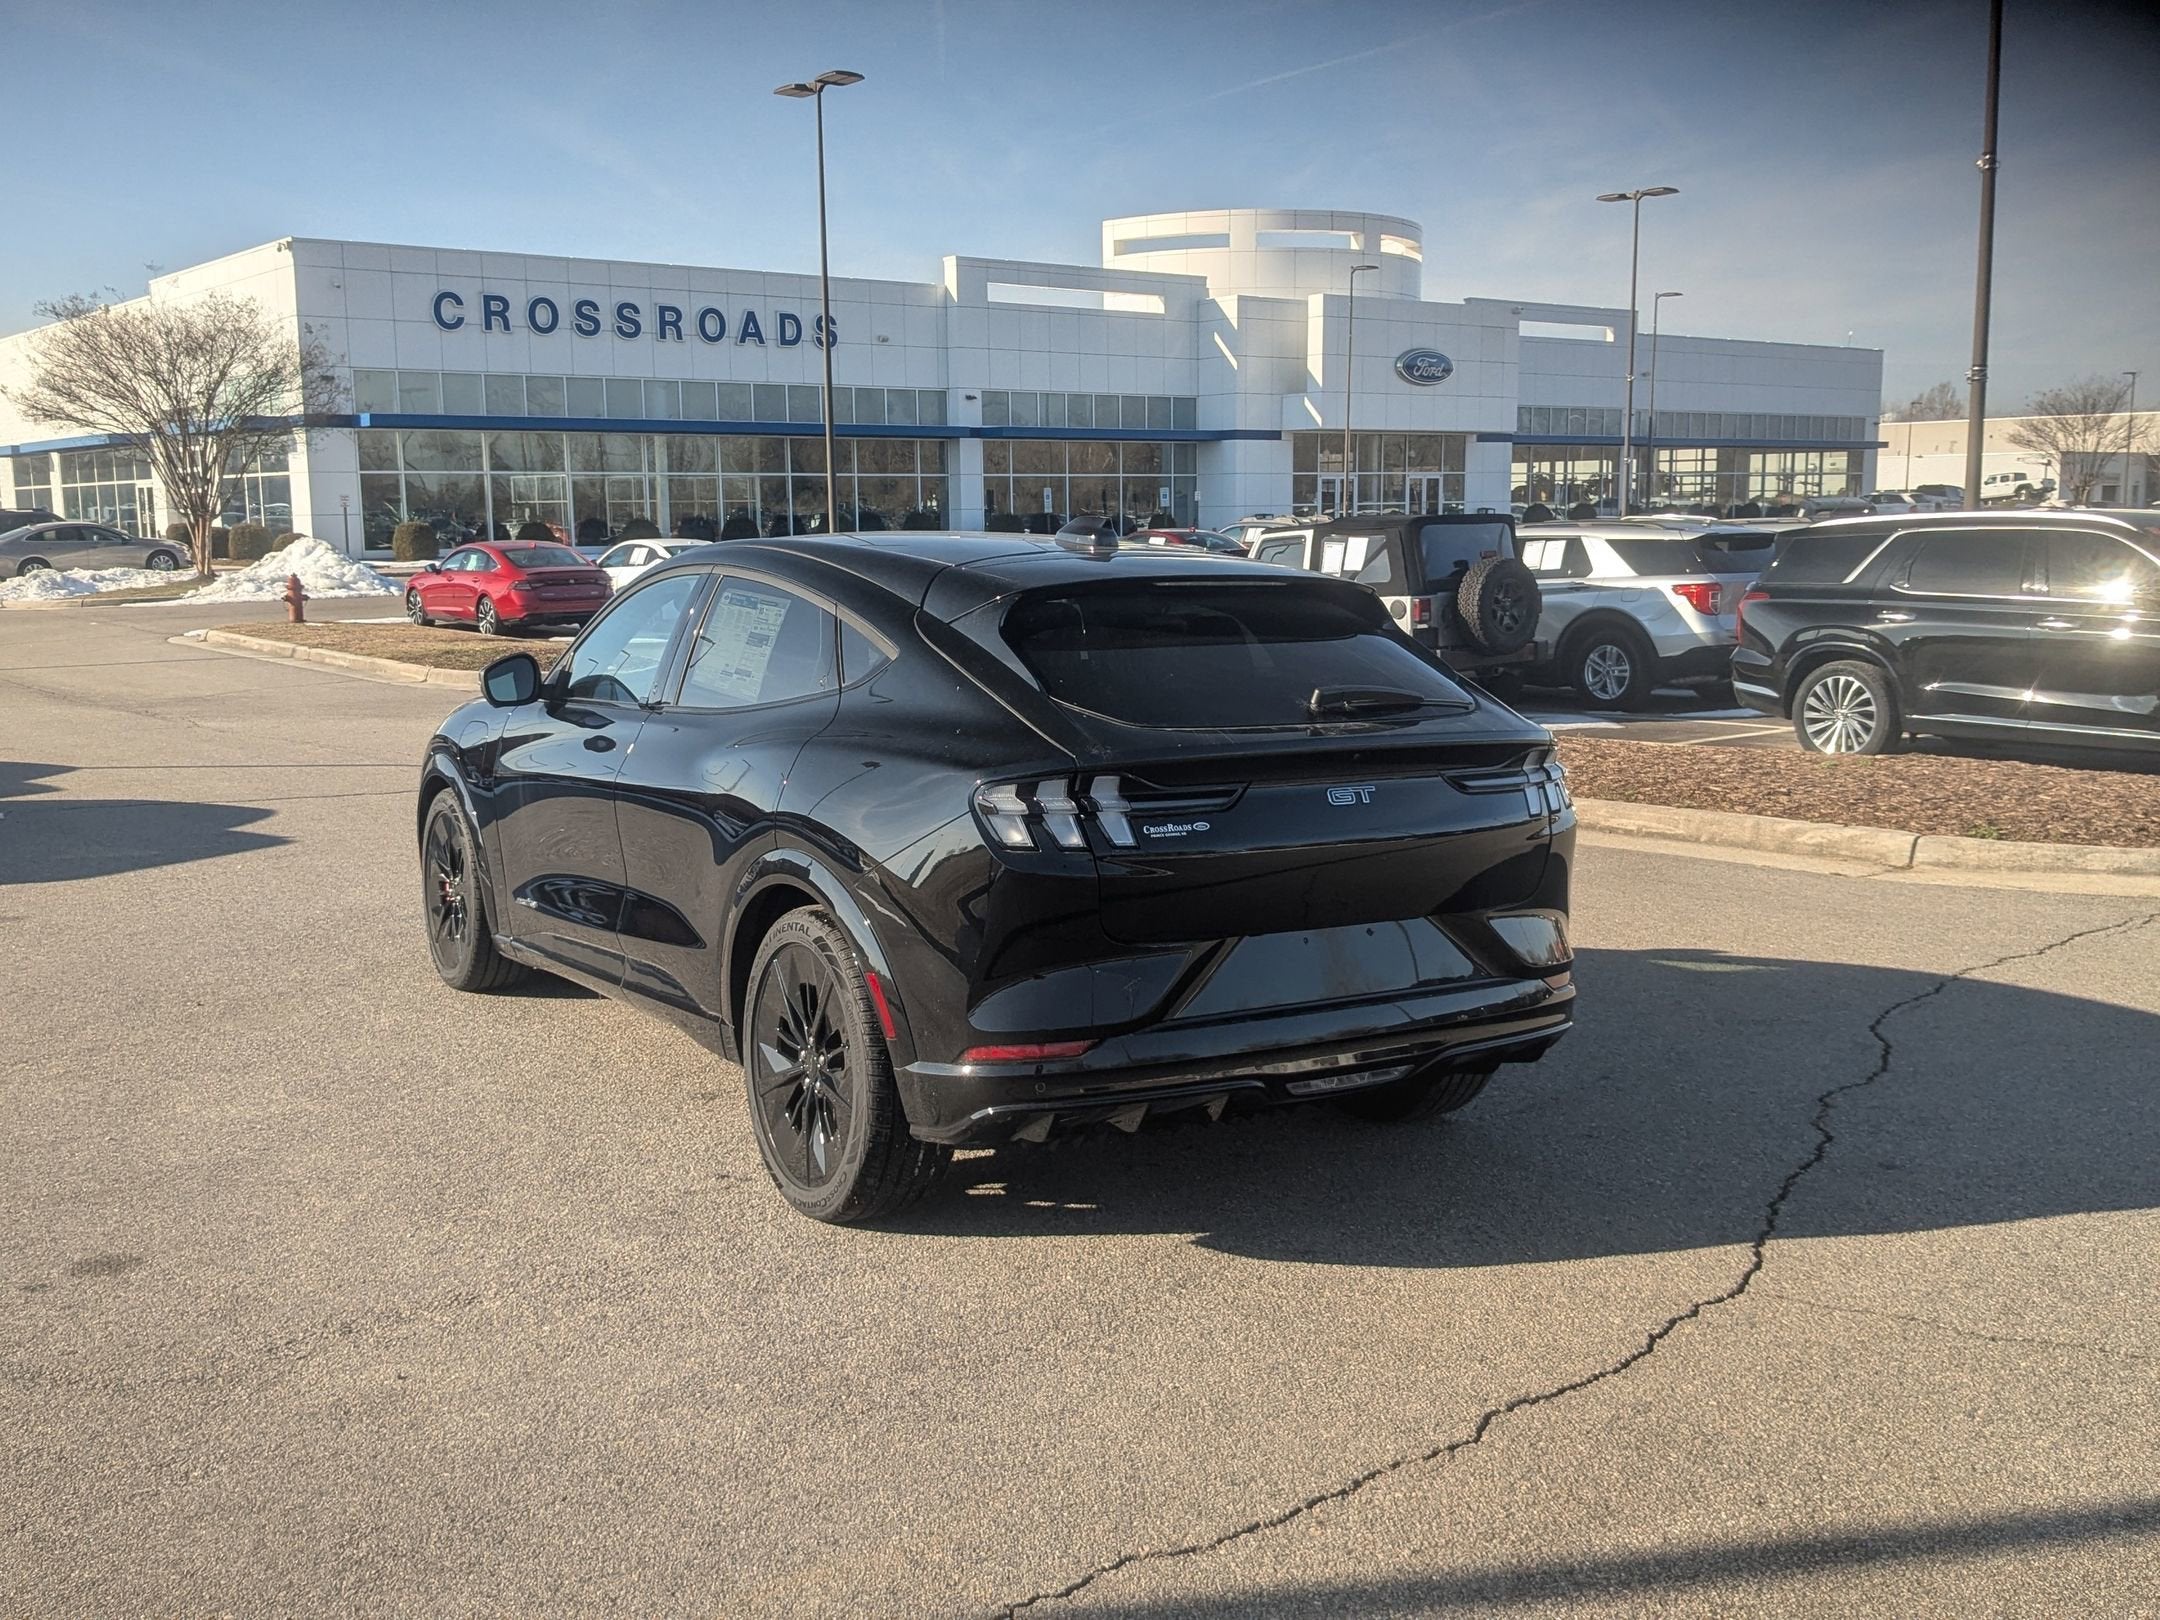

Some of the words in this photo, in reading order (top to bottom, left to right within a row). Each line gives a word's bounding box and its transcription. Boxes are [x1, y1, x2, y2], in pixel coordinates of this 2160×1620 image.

[432, 289, 839, 350] CROSSROADS
[1413, 356, 1449, 377] Ford
[1327, 785, 1376, 806] GT
[755, 921, 811, 968] NTINENTAL
